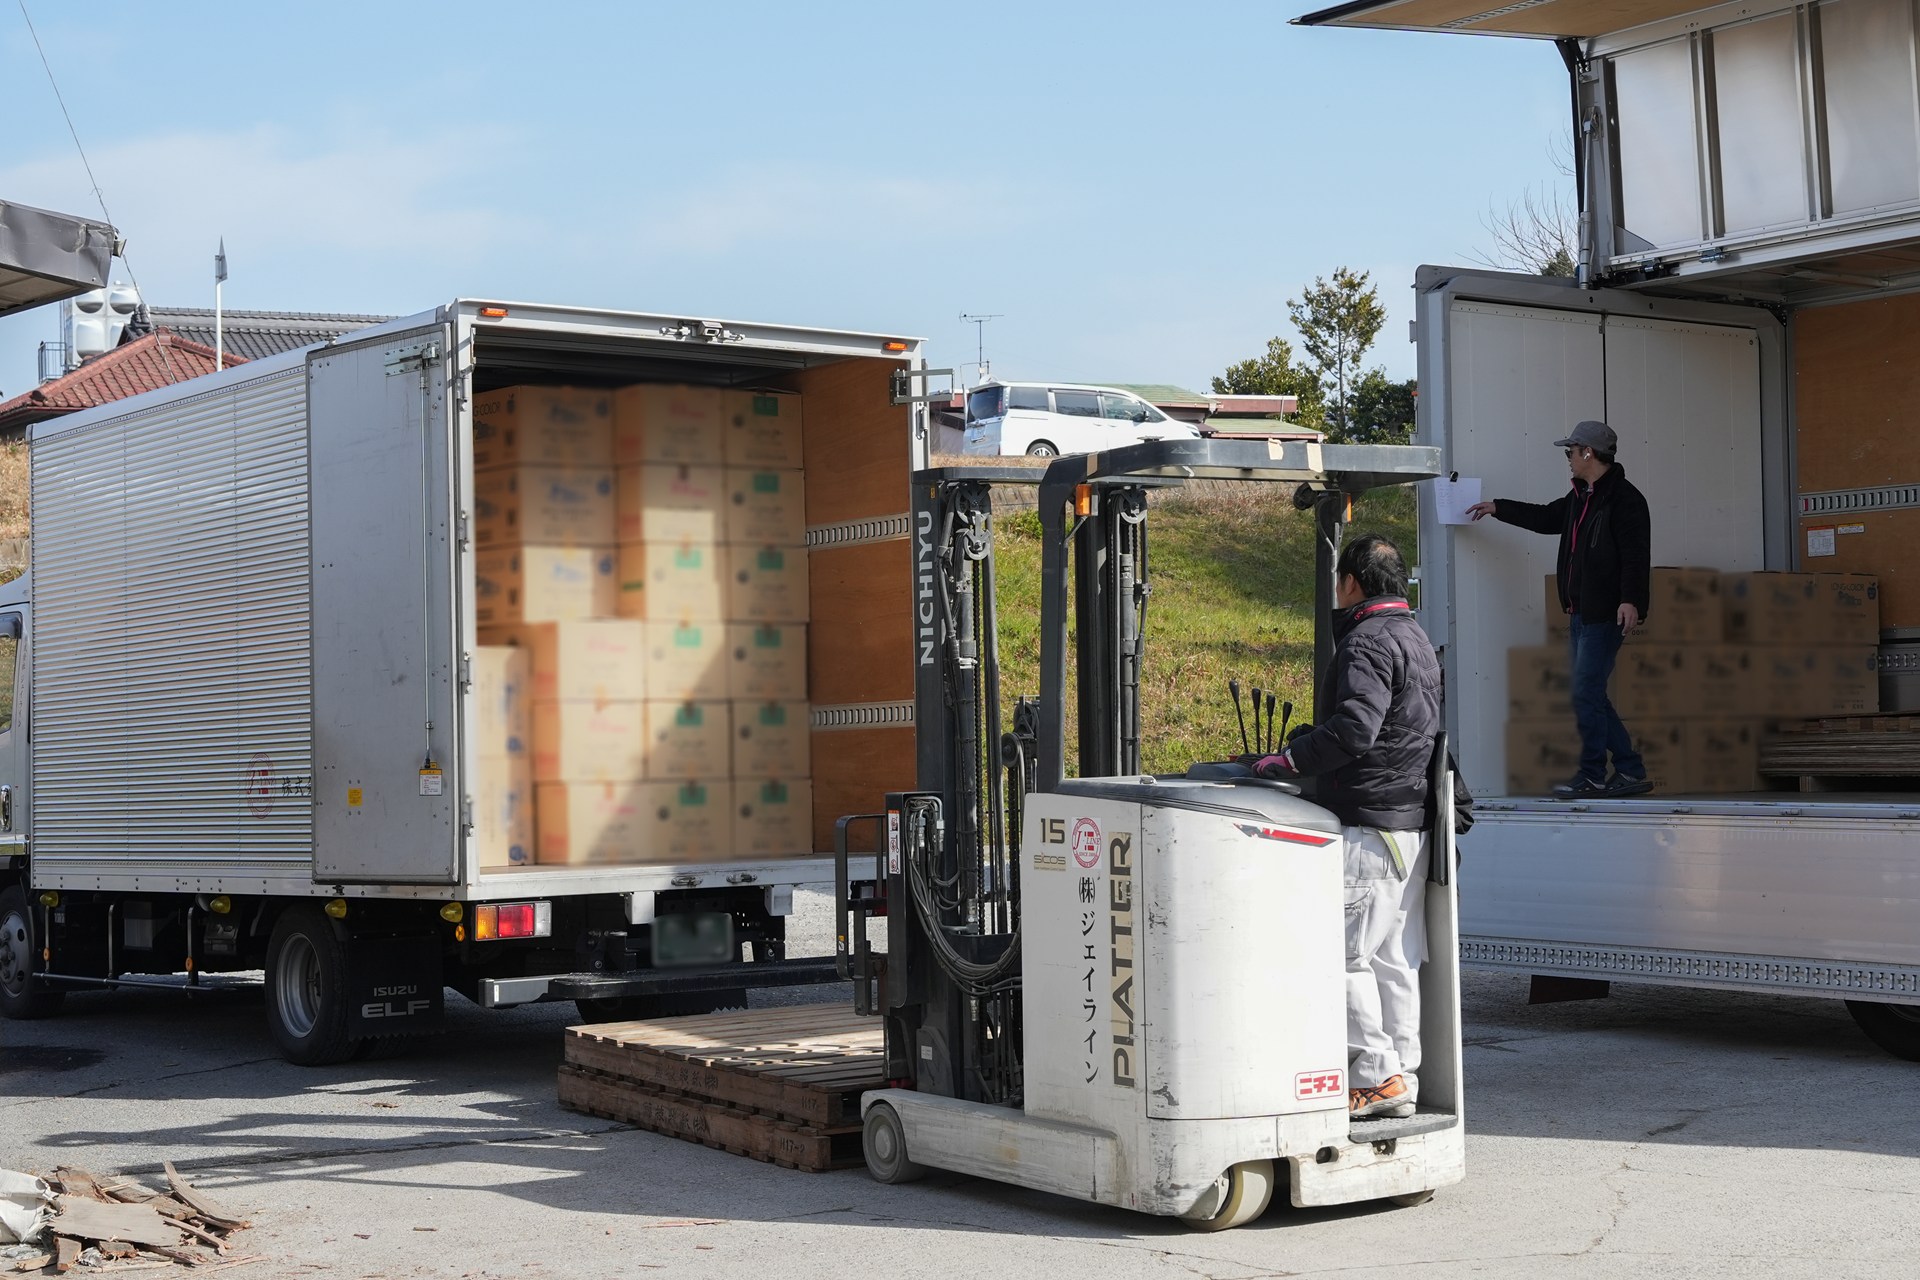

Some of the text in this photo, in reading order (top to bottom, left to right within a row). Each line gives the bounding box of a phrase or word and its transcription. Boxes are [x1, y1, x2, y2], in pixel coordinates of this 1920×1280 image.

[918, 510, 934, 667] NICHIYU
[1041, 818, 1065, 844] 15
[1109, 836, 1135, 1087] PLATTER
[373, 984, 417, 997] ISUZU
[361, 1000, 431, 1018] ELF
[1299, 1075, 1340, 1095] ニチユ
